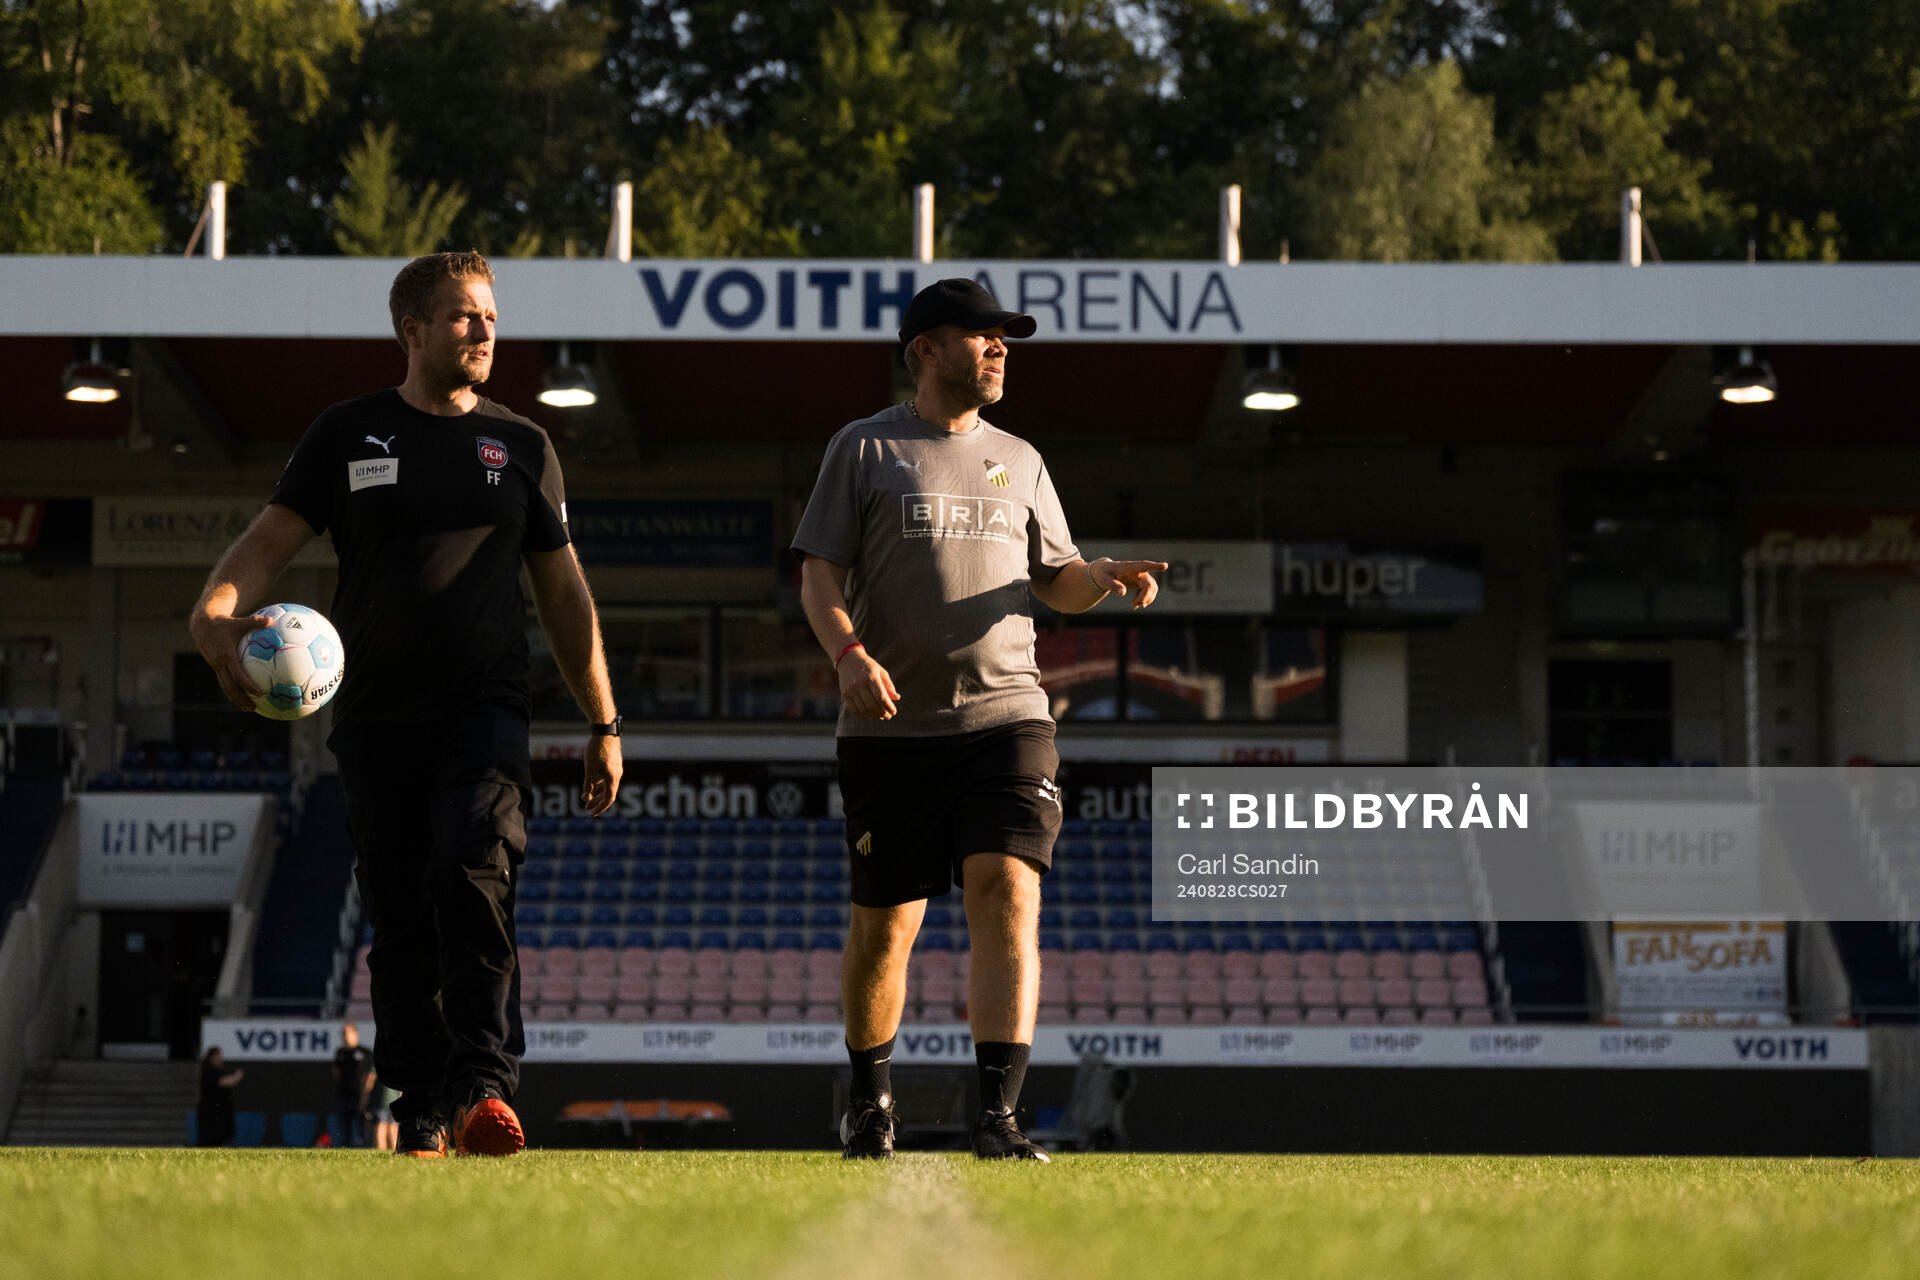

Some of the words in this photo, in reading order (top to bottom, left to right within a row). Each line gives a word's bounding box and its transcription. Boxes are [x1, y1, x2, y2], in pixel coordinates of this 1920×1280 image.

[640, 269, 915, 330] VOITH
[484, 448, 503, 461] FCH
[366, 464, 390, 475] MHP
[487, 470, 501, 486] FF
[1281, 547, 1427, 605] huper
[147, 821, 237, 855] MHP
[237, 1030, 328, 1051] VOITH
[903, 1034, 972, 1056] VOIT
[1068, 1034, 1161, 1056] VOITH
[1735, 1037, 1829, 1060] VOITH
